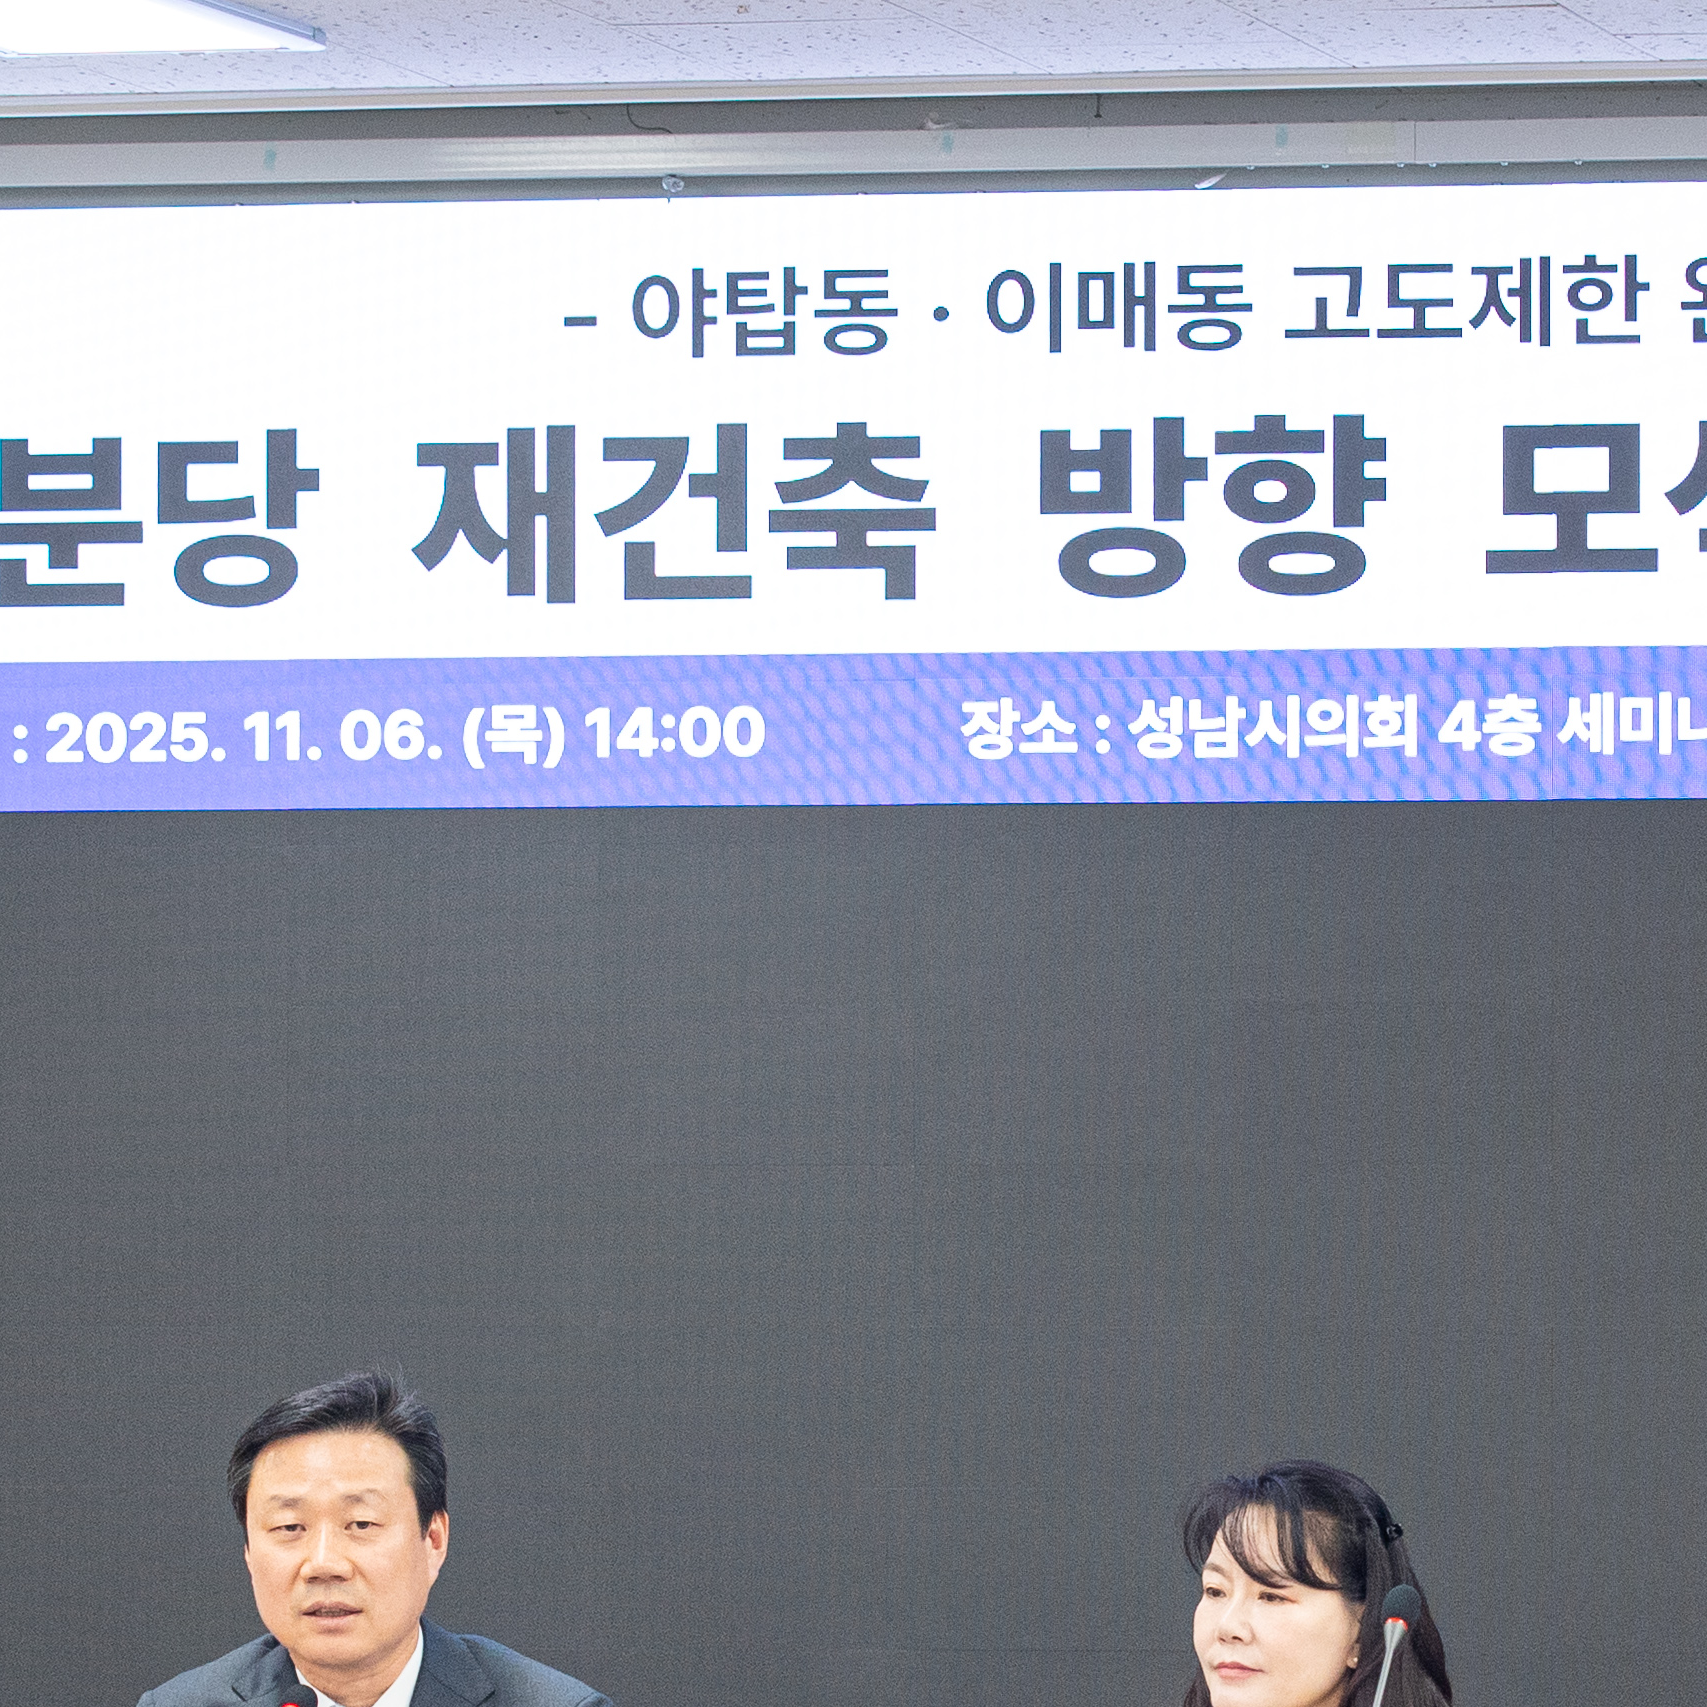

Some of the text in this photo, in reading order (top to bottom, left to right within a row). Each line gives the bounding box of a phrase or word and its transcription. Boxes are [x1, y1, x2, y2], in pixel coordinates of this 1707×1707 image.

[631, 266, 899, 359] 야탑동
[985, 261, 1253, 354] 이매동
[1283, 254, 1651, 347] 고도제한
[410, 421, 937, 605] 재건축
[1039, 414, 1387, 600] 방향
[44, 710, 227, 764] 2025.
[243, 710, 323, 762] 11.
[339, 707, 444, 761] 06.
[461, 704, 566, 770] (목)
[583, 704, 767, 759] 14:00
[959, 696, 1080, 760] 장소
[1126, 693, 1419, 760] 성남시의회
[1437, 692, 1543, 757] 4층
